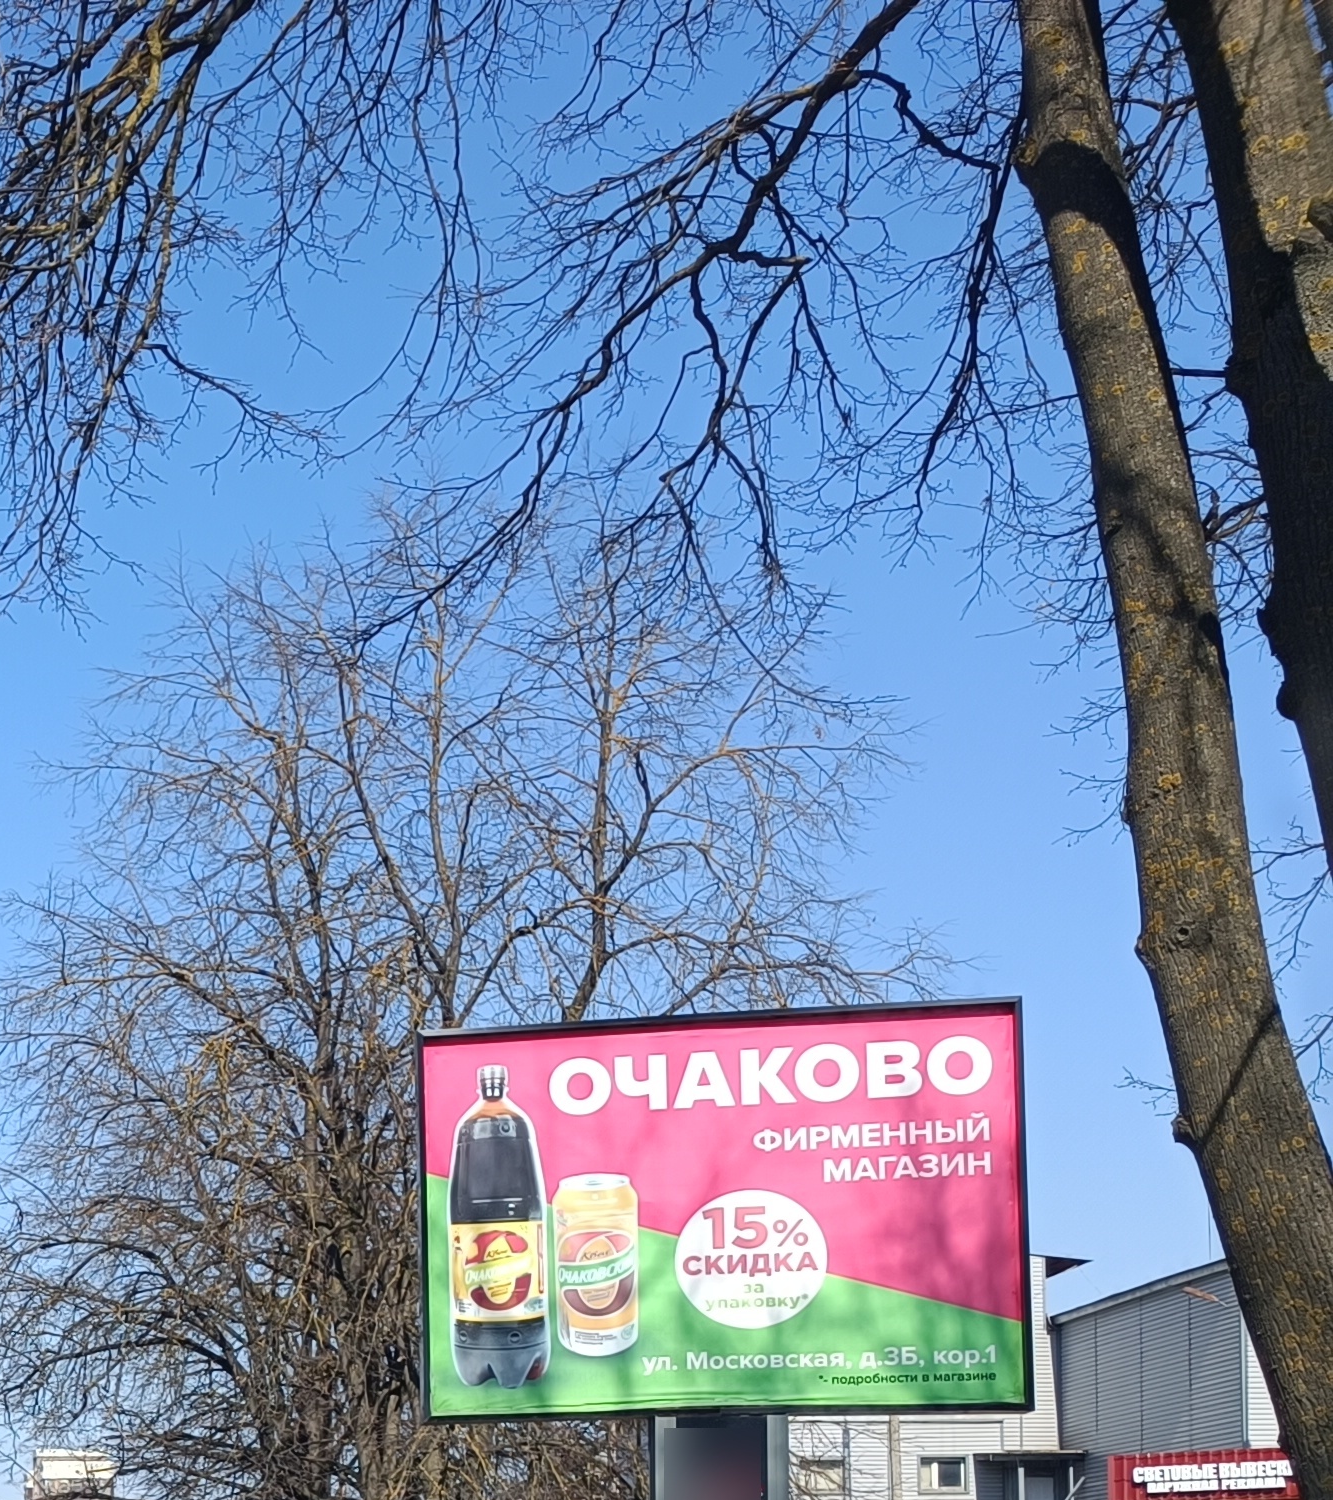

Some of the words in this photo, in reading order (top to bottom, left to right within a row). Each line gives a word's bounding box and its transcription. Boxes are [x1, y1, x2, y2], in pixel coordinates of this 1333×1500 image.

[548, 1035, 993, 1116] ОЧАКОВО
[752, 1111, 991, 1152] ФИРМЕННЫЙ
[822, 1151, 992, 1183] МАГАЗИН
[702, 1206, 809, 1249] 15%
[682, 1251, 819, 1277] СКИДКА
[743, 1283, 765, 1293] за
[641, 1354, 678, 1375] ул.
[686, 1350, 853, 1370] Московская,
[933, 1344, 996, 1367] кор.1
[831, 1372, 918, 1386] подробности
[921, 1373, 930, 1382] в
[933, 1371, 997, 1382] магазине
[1132, 1463, 1218, 1484] СВЕТОВЫЕ
[1221, 1476, 1287, 1490] РЕКЛАМА
